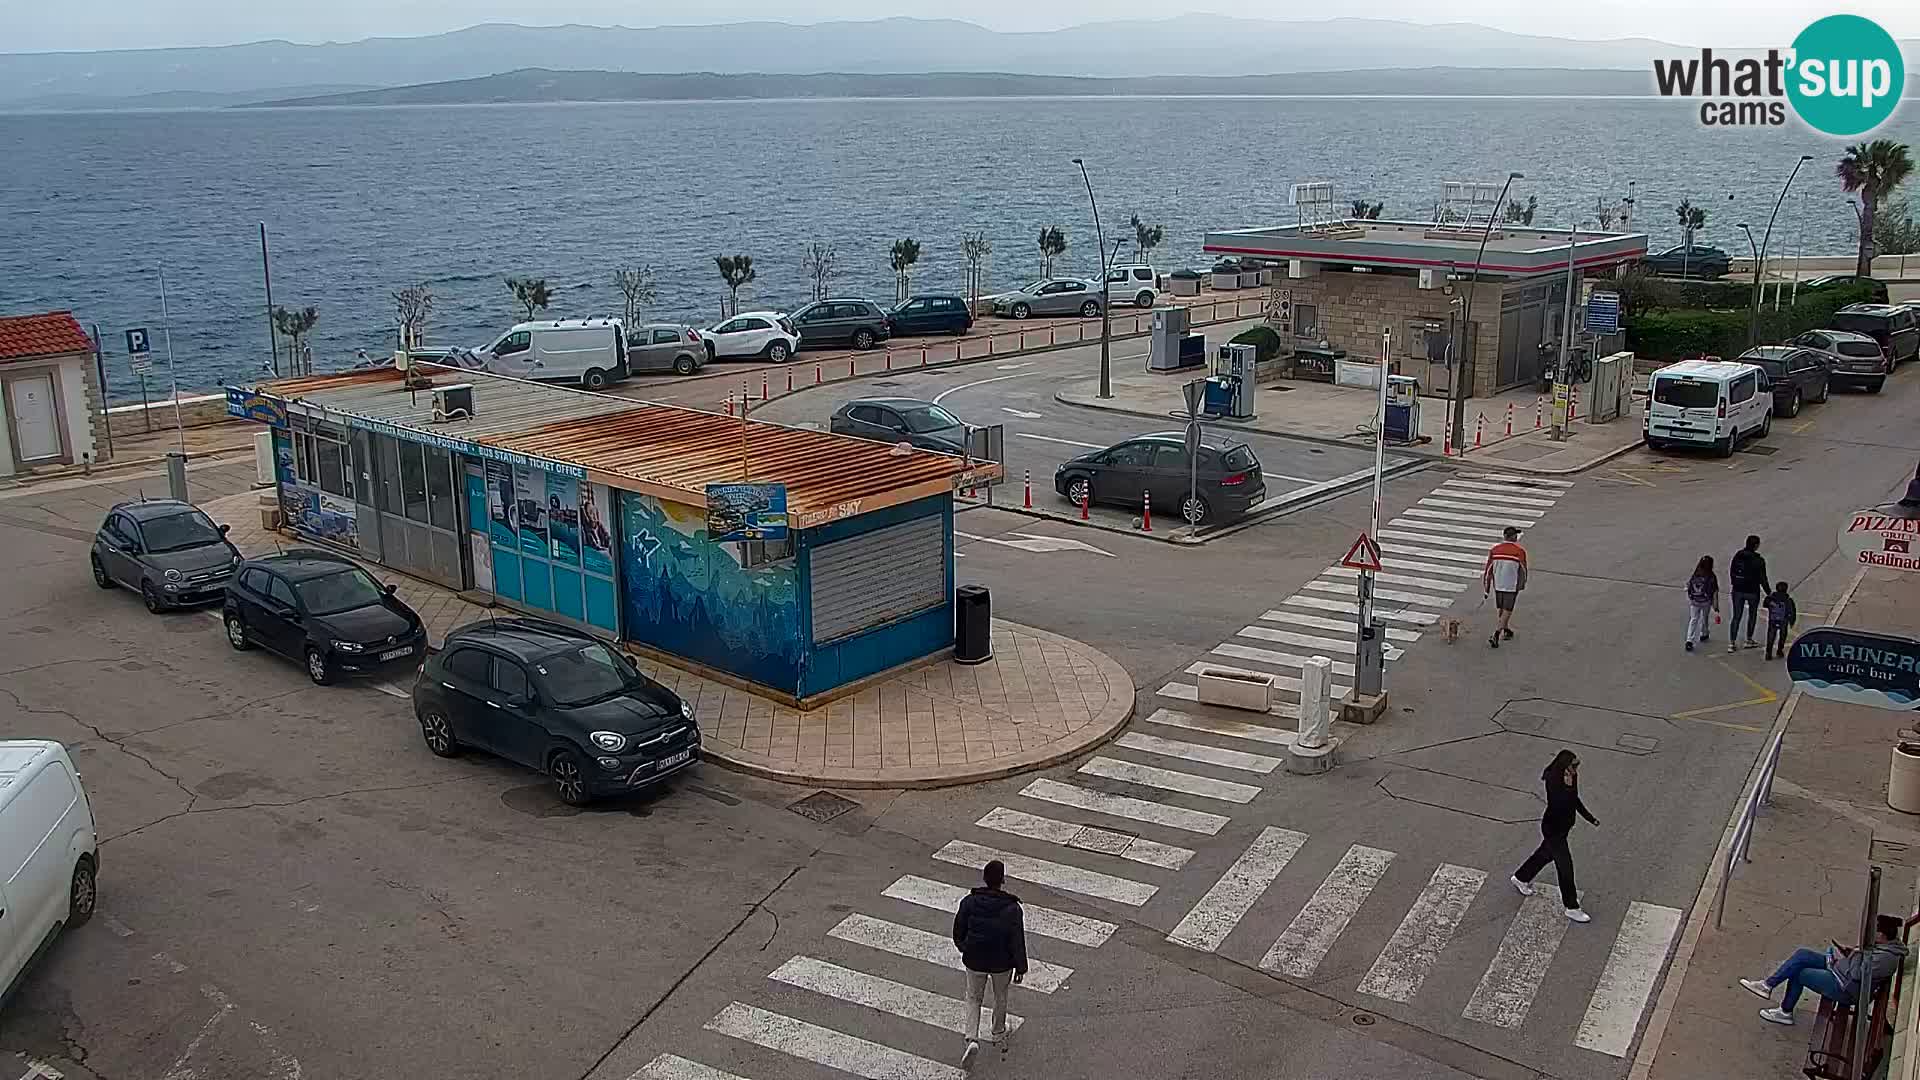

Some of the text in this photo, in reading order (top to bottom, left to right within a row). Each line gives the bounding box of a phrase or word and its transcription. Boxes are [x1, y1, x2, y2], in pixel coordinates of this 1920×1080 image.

[131, 332, 144, 350] P
[479, 446, 494, 458] BUS
[494, 450, 527, 465] STATION
[528, 457, 555, 471] TICKET
[556, 462, 583, 477] OFFICE
[1846, 515, 1920, 534] PIZZE
[1881, 531, 1917, 542] GRILL
[1869, 666, 1896, 681] bar
